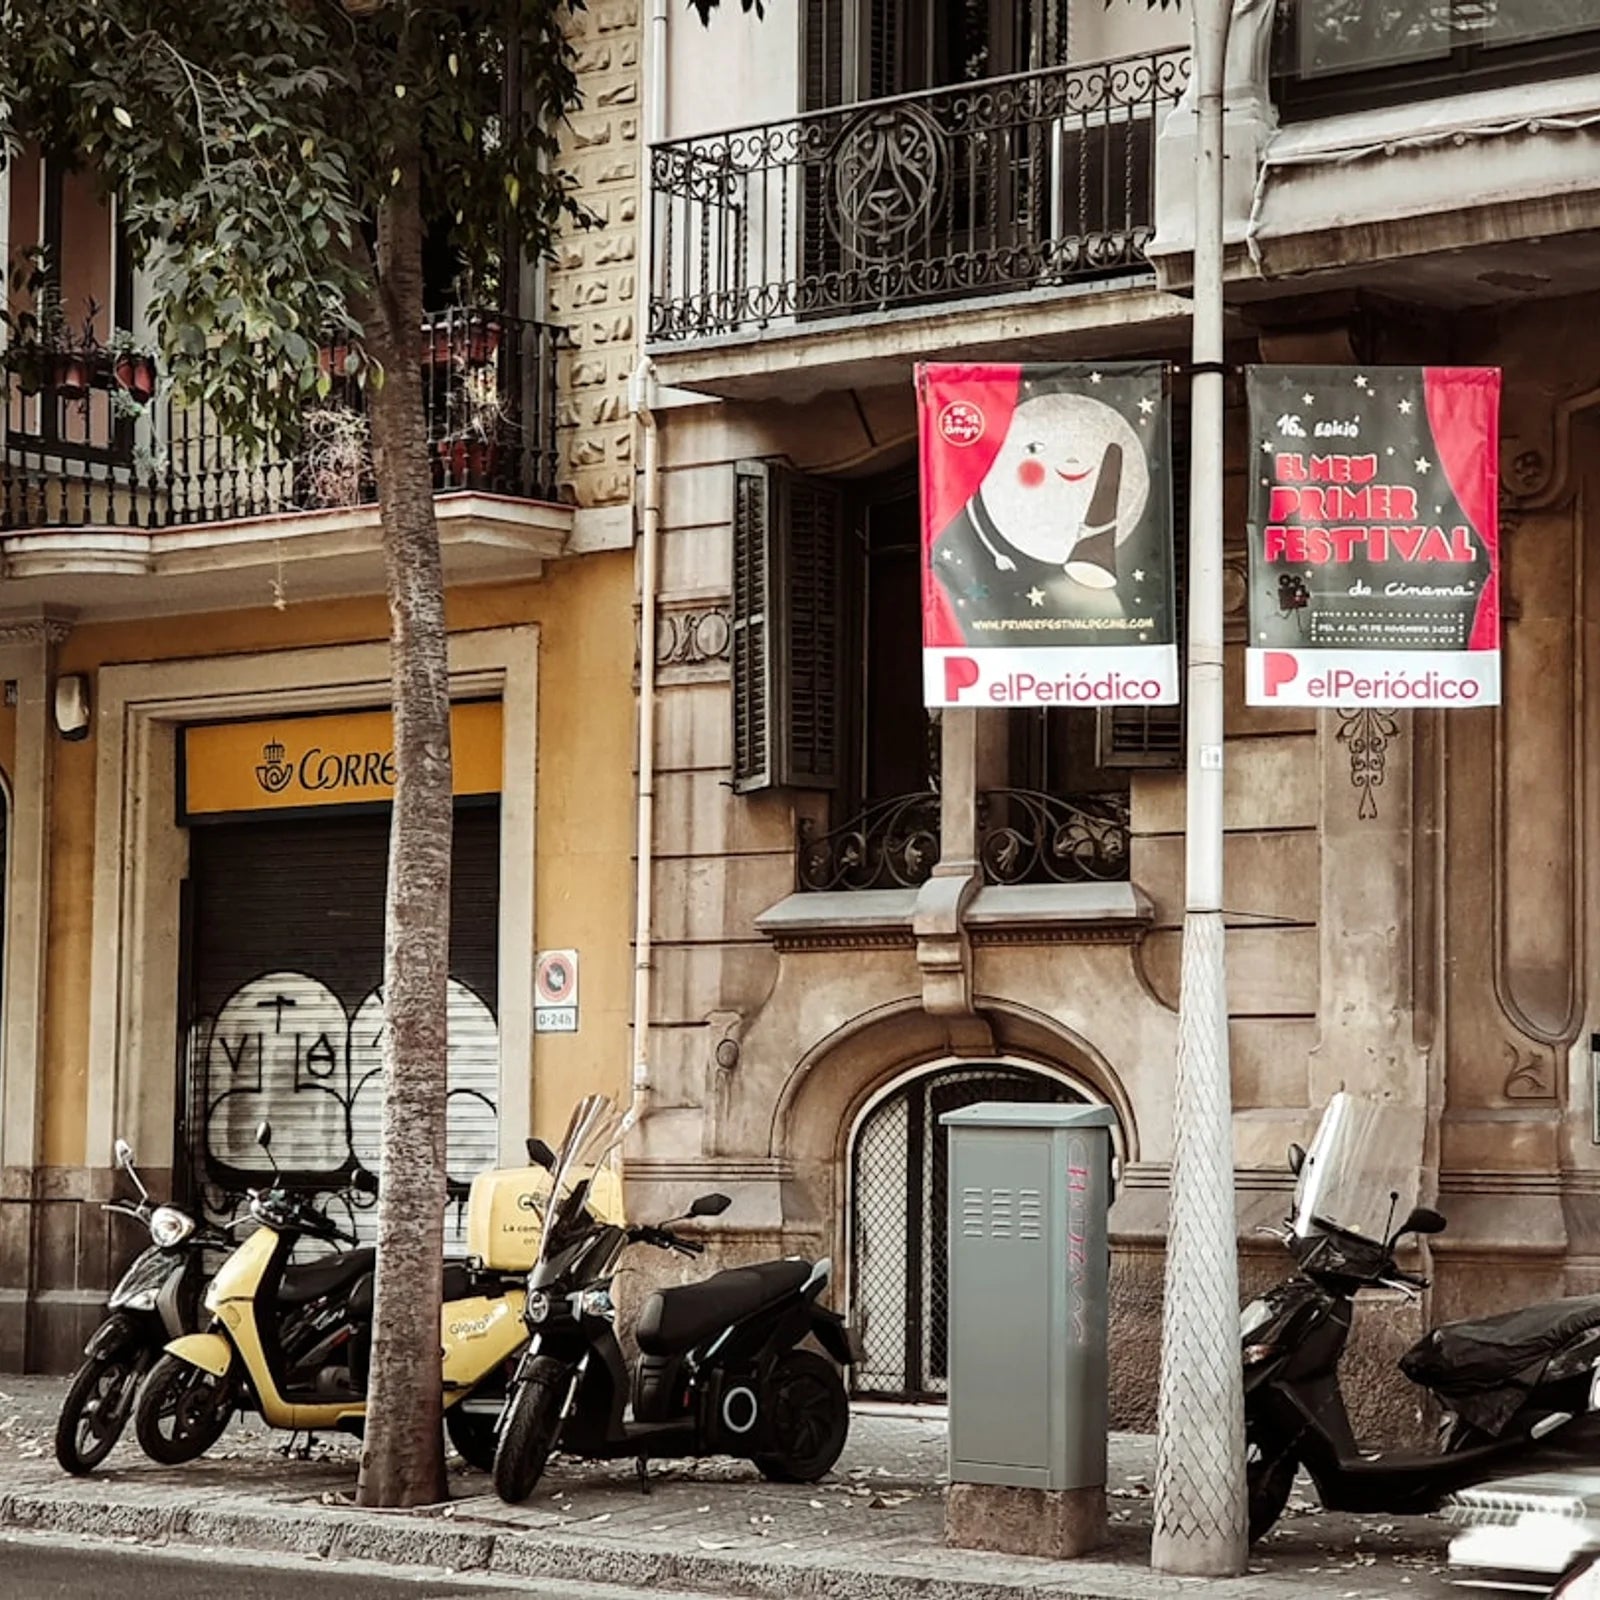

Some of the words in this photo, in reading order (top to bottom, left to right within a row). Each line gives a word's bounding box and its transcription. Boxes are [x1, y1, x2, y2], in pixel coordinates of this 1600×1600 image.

[1275, 452, 1308, 482] EL
[1309, 453, 1377, 484] MEU
[1269, 485, 1418, 522] PRIMER
[1264, 525, 1477, 564] FESTIVAL
[1349, 579, 1372, 596] de
[944, 656, 979, 702] P
[988, 673, 1161, 701] elPeriódico
[1264, 652, 1298, 696] P
[1307, 670, 1479, 699] elPeriódico
[299, 748, 395, 790] CORRE
